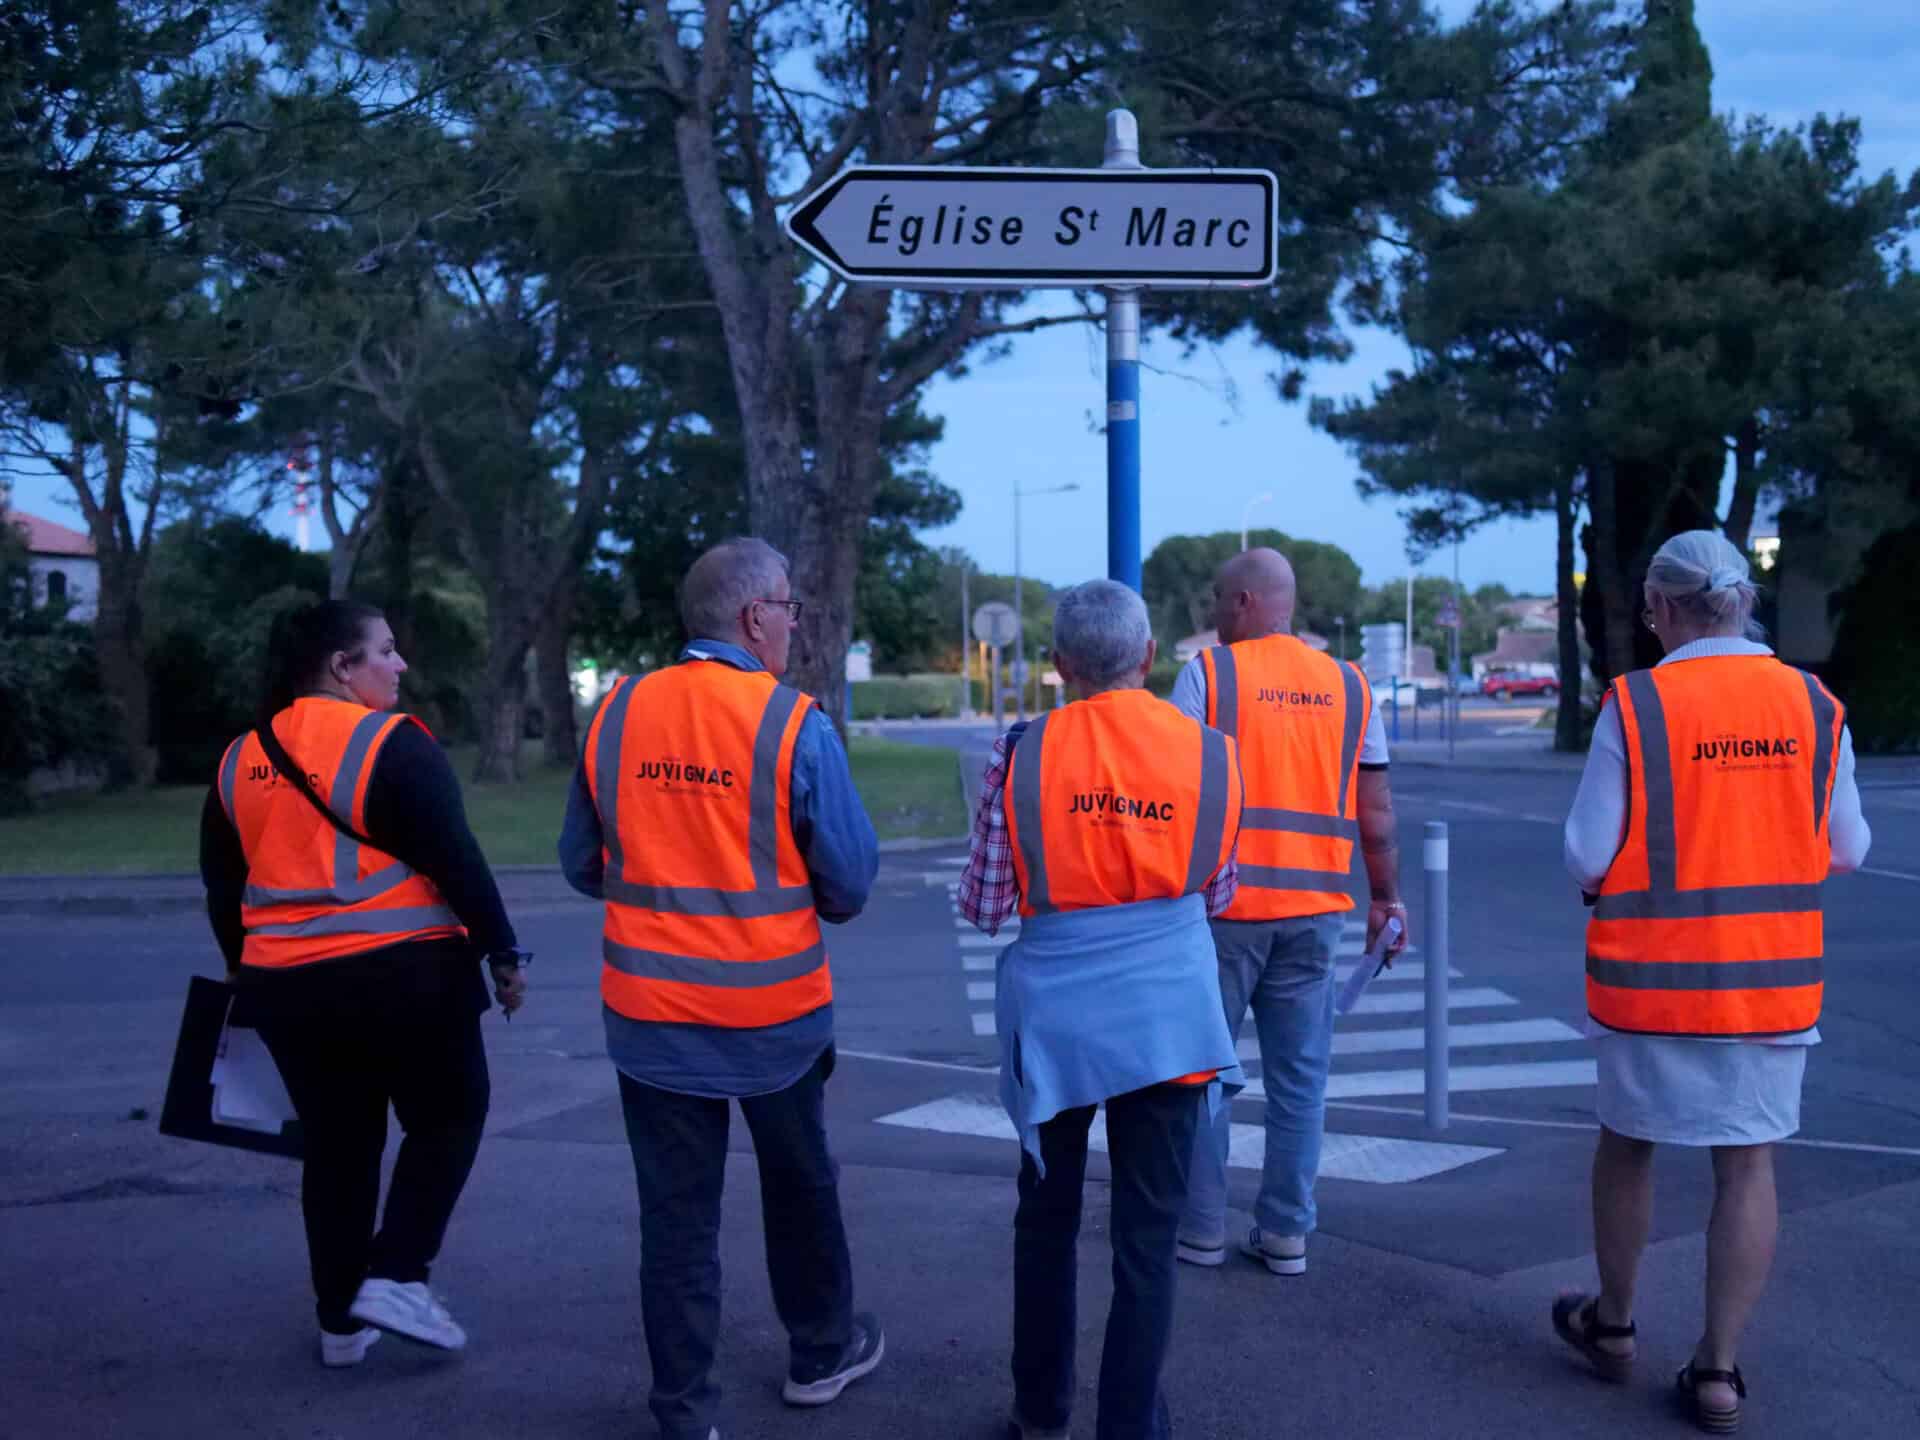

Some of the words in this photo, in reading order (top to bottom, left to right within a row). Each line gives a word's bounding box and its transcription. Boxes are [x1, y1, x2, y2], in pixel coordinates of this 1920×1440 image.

[866, 194, 1024, 254] Église
[1054, 206, 1100, 246] St
[1125, 206, 1251, 248] Marc
[1256, 687, 1333, 706] JUVIGNAC
[1691, 737, 1798, 761] JUVIGNAC
[636, 761, 733, 788] JUVIGNAC
[1068, 792, 1174, 822] JUVIGNAC
